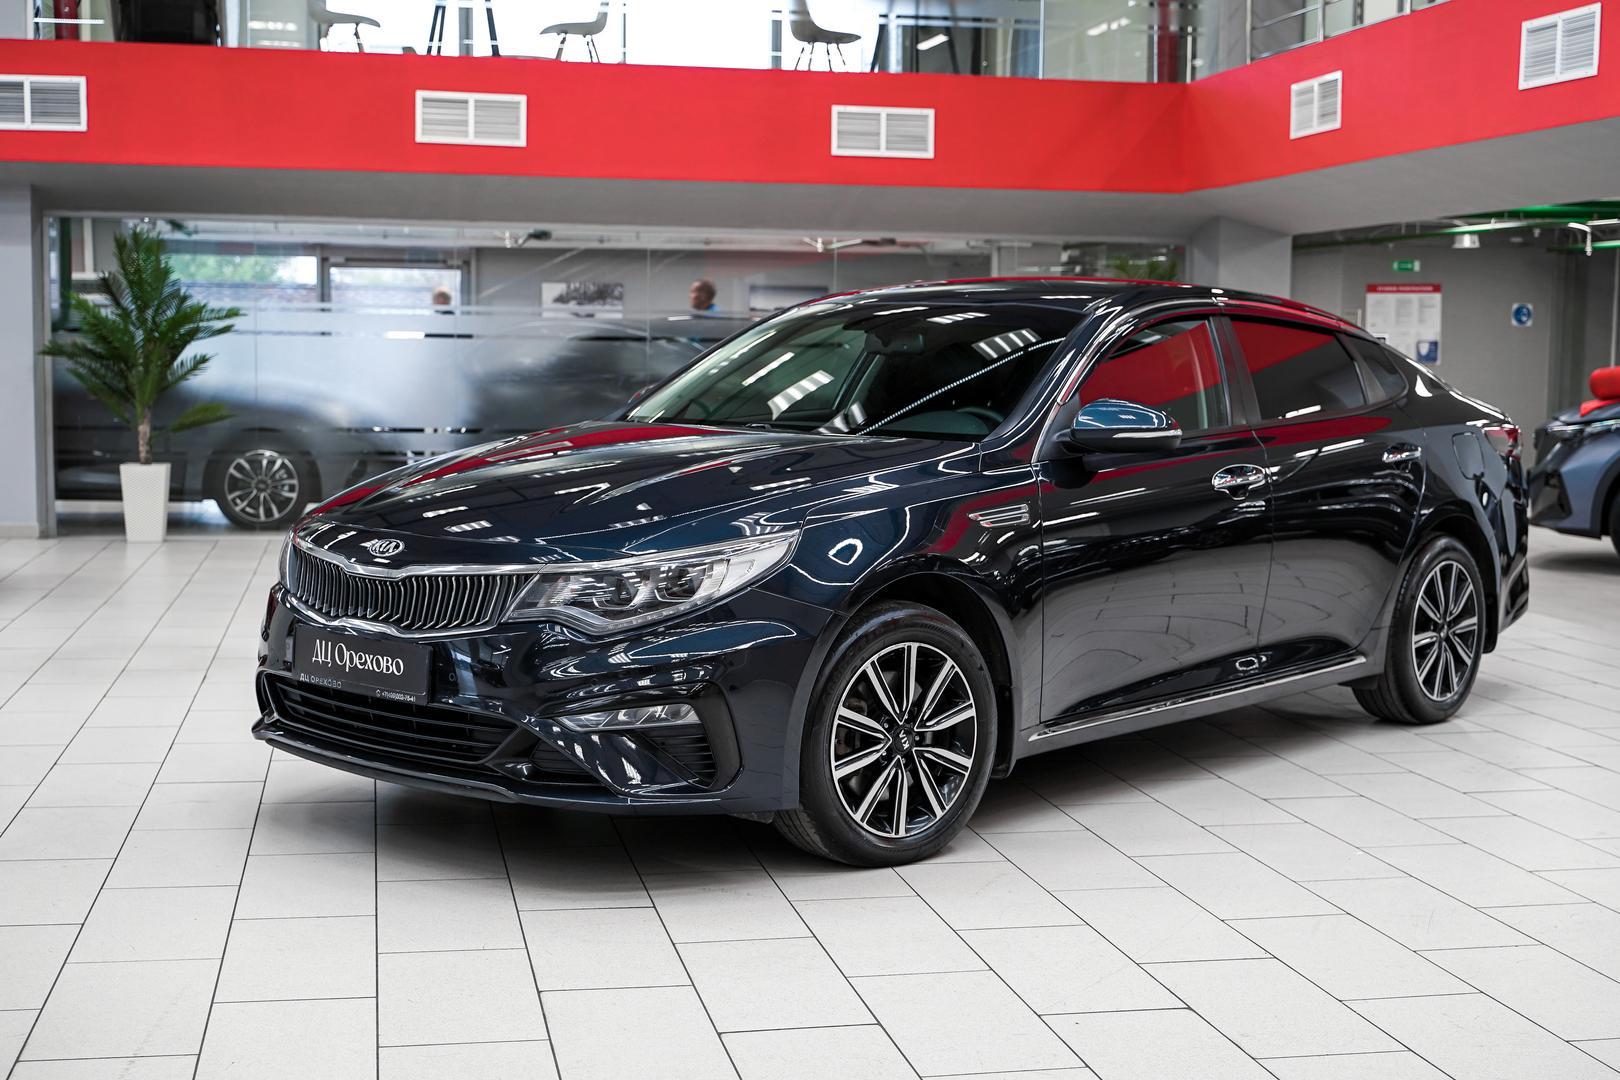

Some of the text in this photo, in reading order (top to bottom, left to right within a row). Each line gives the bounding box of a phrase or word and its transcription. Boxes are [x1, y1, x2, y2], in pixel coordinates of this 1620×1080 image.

[371, 540, 398, 553] KIA
[312, 639, 404, 676] ДЦ Орехово
[899, 730, 909, 749] KIA
